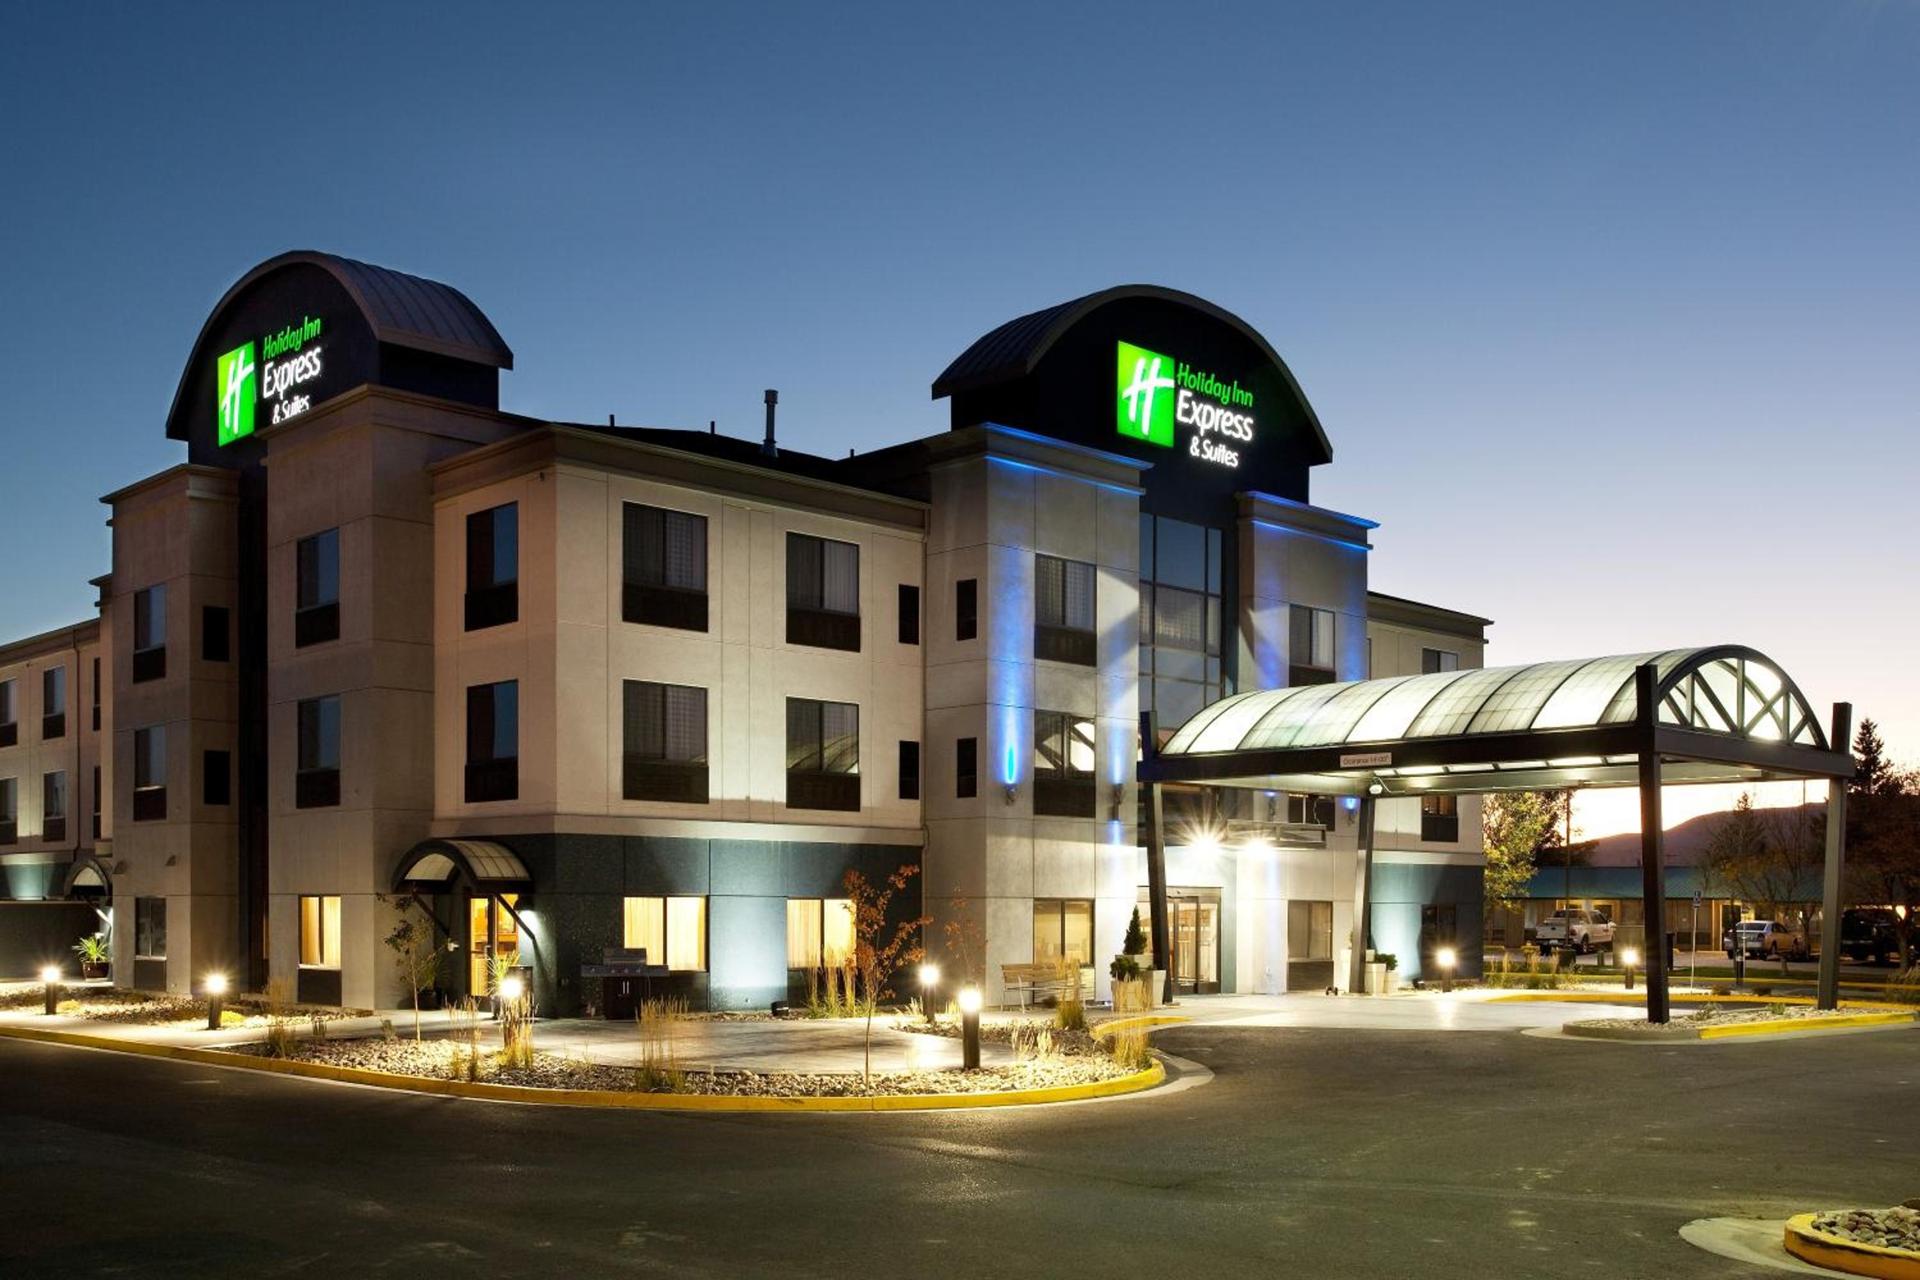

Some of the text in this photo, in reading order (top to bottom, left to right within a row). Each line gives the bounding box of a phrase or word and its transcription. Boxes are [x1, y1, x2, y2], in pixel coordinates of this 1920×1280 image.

[263, 315, 321, 361] Holiday Inn
[262, 346, 322, 401] Express
[1176, 362, 1253, 407] Holiday Inn
[272, 394, 310, 425] & Suites
[1176, 388, 1254, 442] Express
[1189, 435, 1240, 468] & Suites
